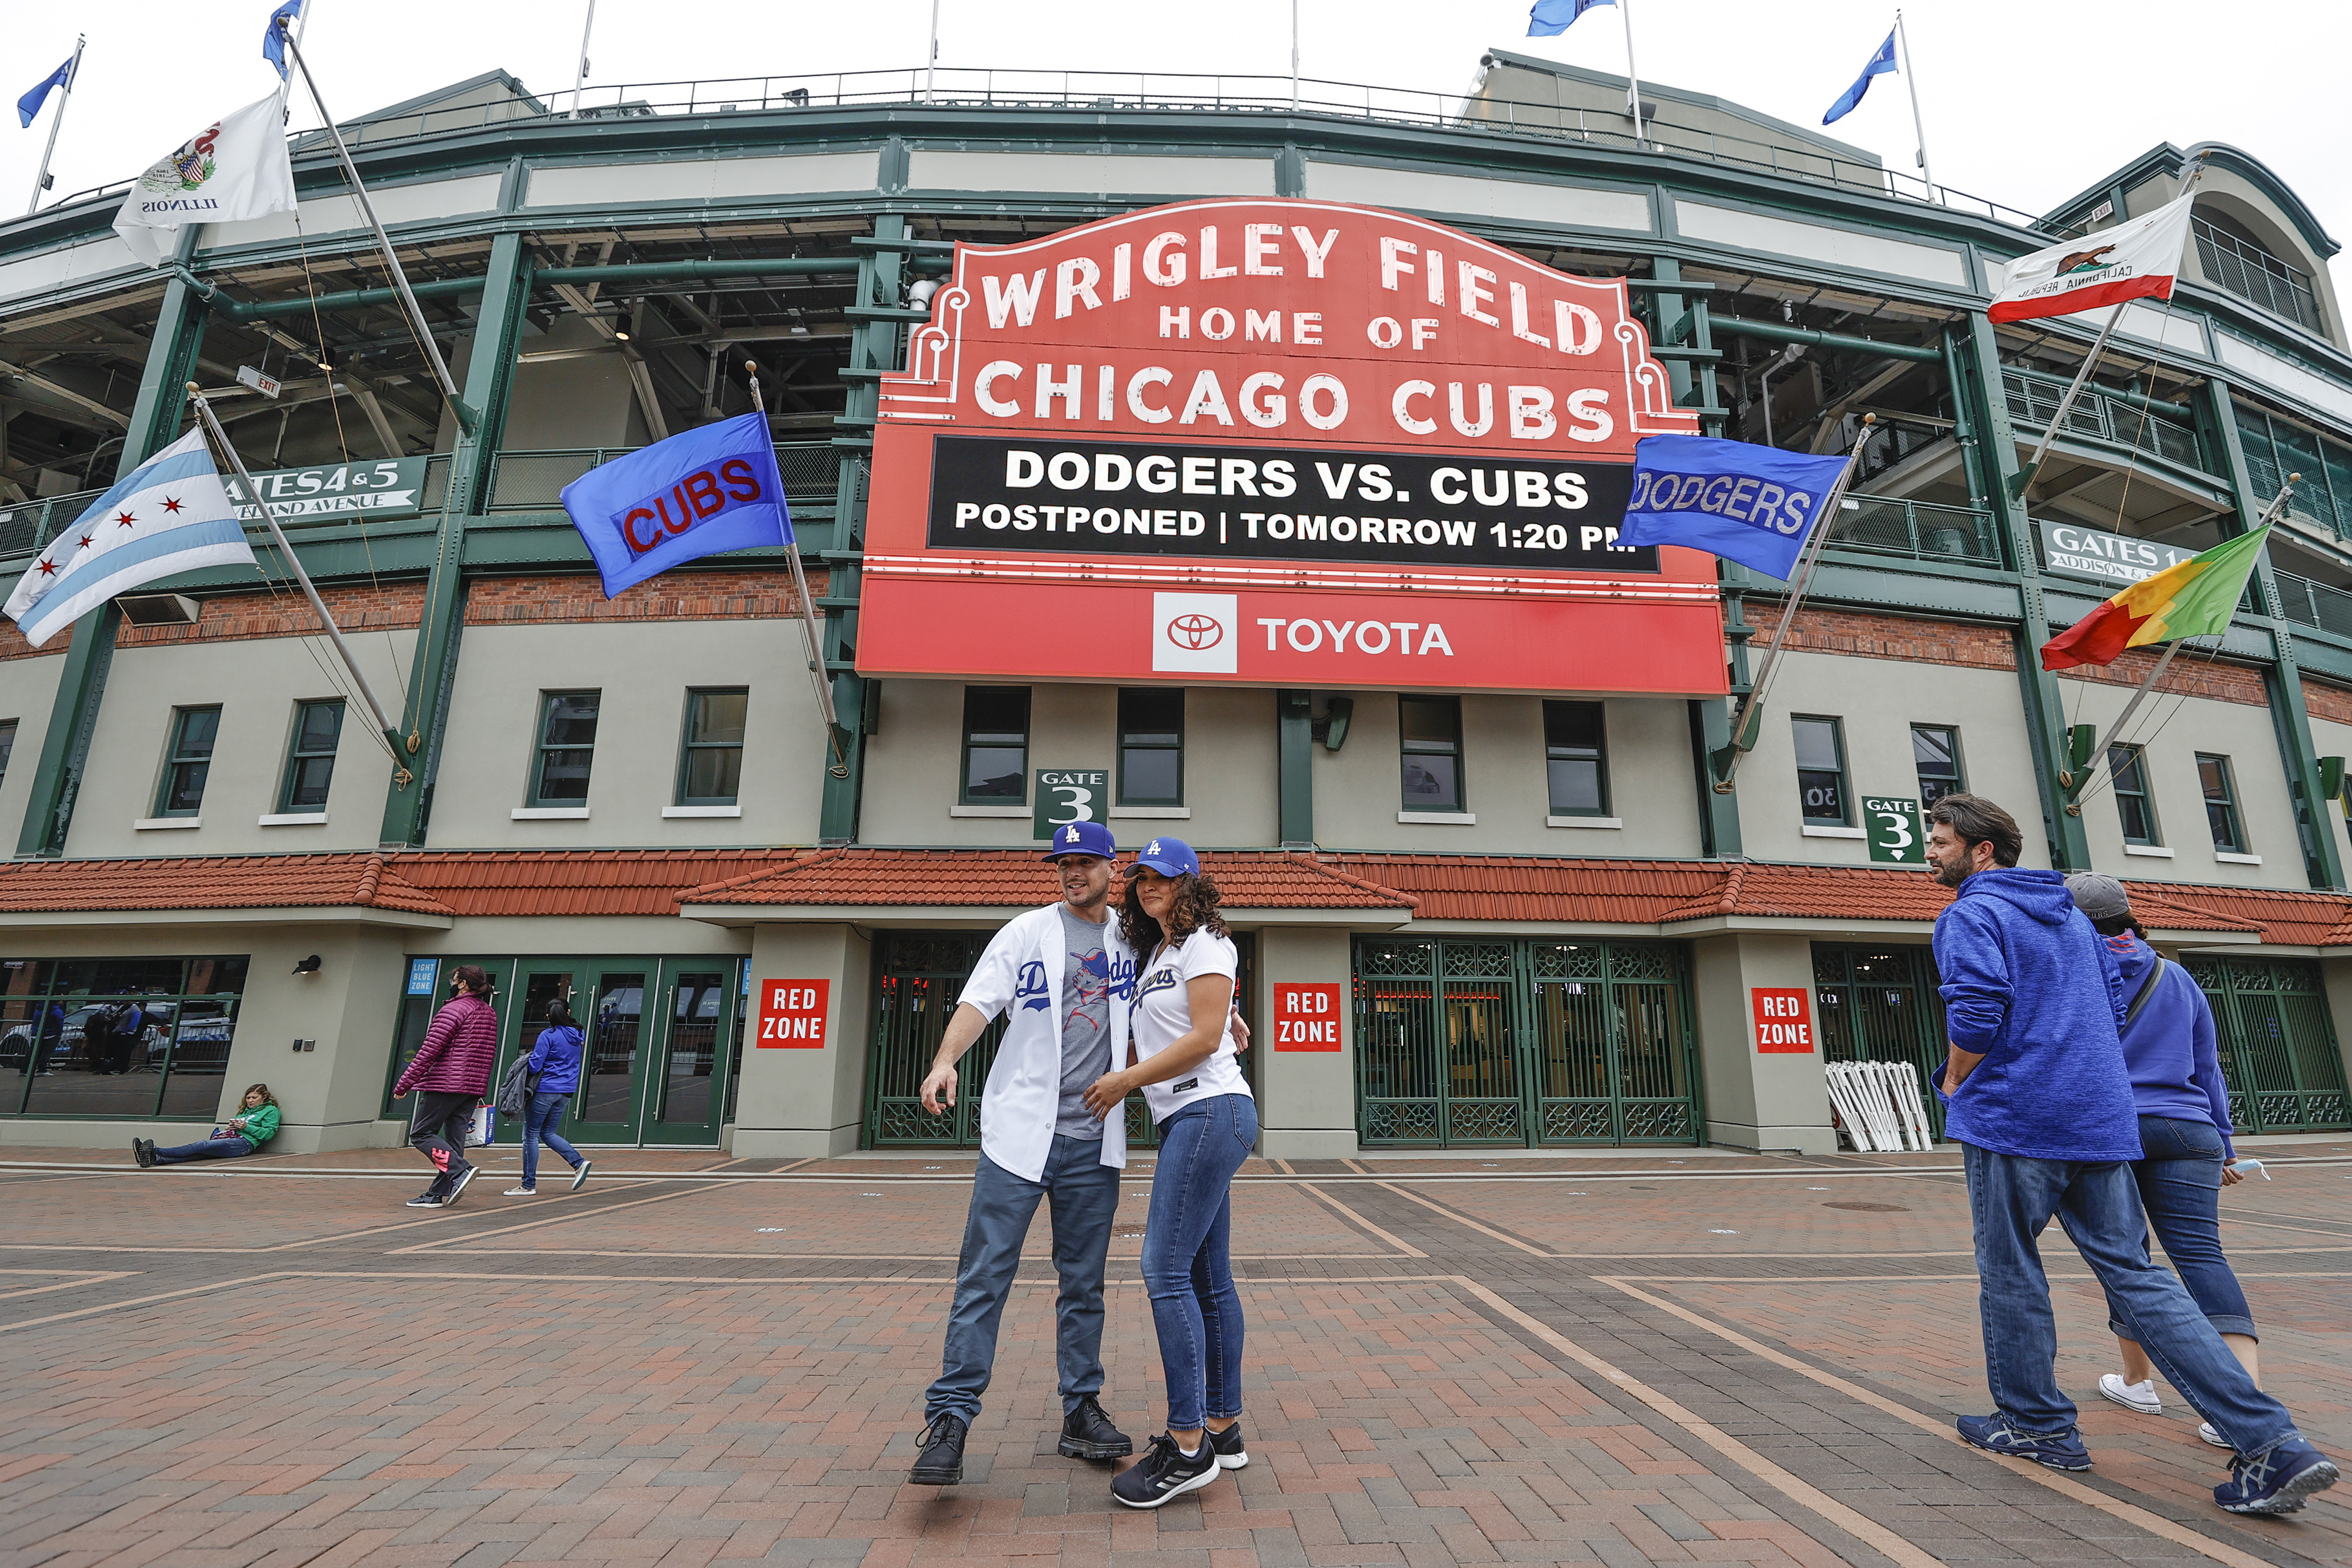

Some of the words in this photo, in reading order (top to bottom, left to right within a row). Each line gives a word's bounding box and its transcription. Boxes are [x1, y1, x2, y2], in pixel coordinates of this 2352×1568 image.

[2094, 204, 2109, 218] EXIT
[981, 223, 1340, 329] WRIGLEY
[1380, 236, 1603, 356] FIELD
[1159, 305, 1323, 345] HOME
[1367, 316, 1439, 350] OF
[259, 377, 276, 393] EXIT
[974, 360, 1349, 430] CHICAGO
[1391, 379, 1614, 442] CUBS
[225, 470, 323, 501] ATES
[1005, 450, 1297, 499] DODGERS
[1315, 462, 1409, 502] VS.
[1430, 467, 1589, 509] CUBS
[308, 493, 386, 512] AVENUE
[624, 459, 761, 552] CUBS
[1628, 472, 1810, 535] DODGERS
[956, 503, 1205, 536] POSTPONED
[1240, 513, 1476, 546] TOMORROW
[1490, 522, 1568, 550] 1:20
[2052, 528, 2159, 566] GATES
[2057, 554, 2126, 577] ADDISON
[1257, 617, 1454, 656] TOYOTA
[1041, 773, 1103, 784] GATE
[1048, 786, 1093, 824] 3
[1866, 800, 1915, 813] GATE
[1066, 824, 1080, 844] LA
[1877, 813, 1913, 848] 3
[1147, 840, 1161, 855] LA
[773, 988, 816, 1009] RED
[1287, 992, 1328, 1013] RED
[1763, 997, 1799, 1017] RED
[762, 1017, 821, 1039] ZONE
[1279, 1021, 1337, 1042] ZONE
[1759, 1024, 1809, 1044] ZONE
